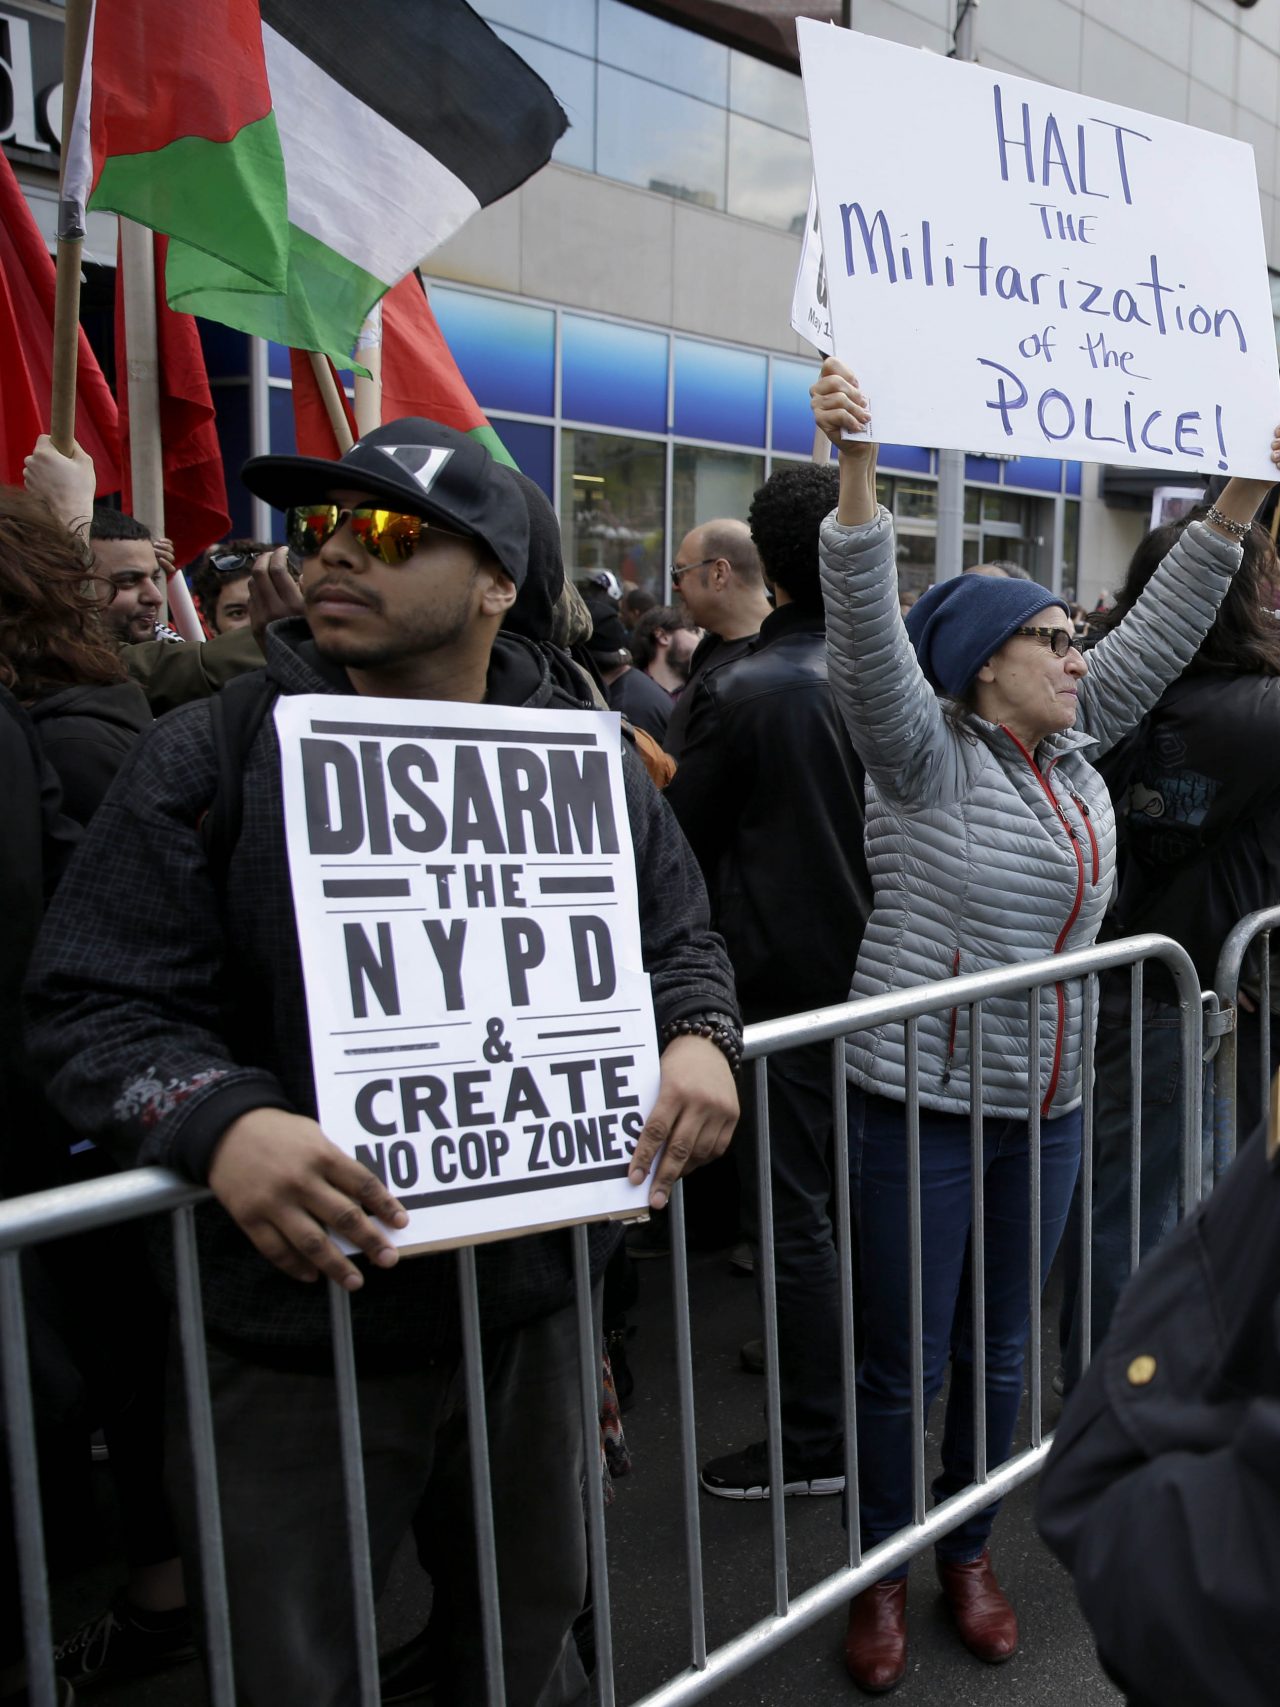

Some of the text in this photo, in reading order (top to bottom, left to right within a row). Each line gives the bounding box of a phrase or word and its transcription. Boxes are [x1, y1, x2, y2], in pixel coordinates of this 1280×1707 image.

[993, 84, 1152, 205] HALT
[1029, 202, 1098, 244] THE
[839, 201, 1247, 353] Militarization
[808, 308, 822, 335] May
[1019, 325, 1152, 380] of the
[977, 357, 1228, 471] POLICE!
[301, 738, 619, 855] DISARM
[425, 864, 528, 909] THE
[343, 914, 617, 1018] NYPD
[482, 1017, 515, 1063] &
[354, 1055, 640, 1136] CREATE
[355, 1111, 645, 1190] NO COP ZONES
